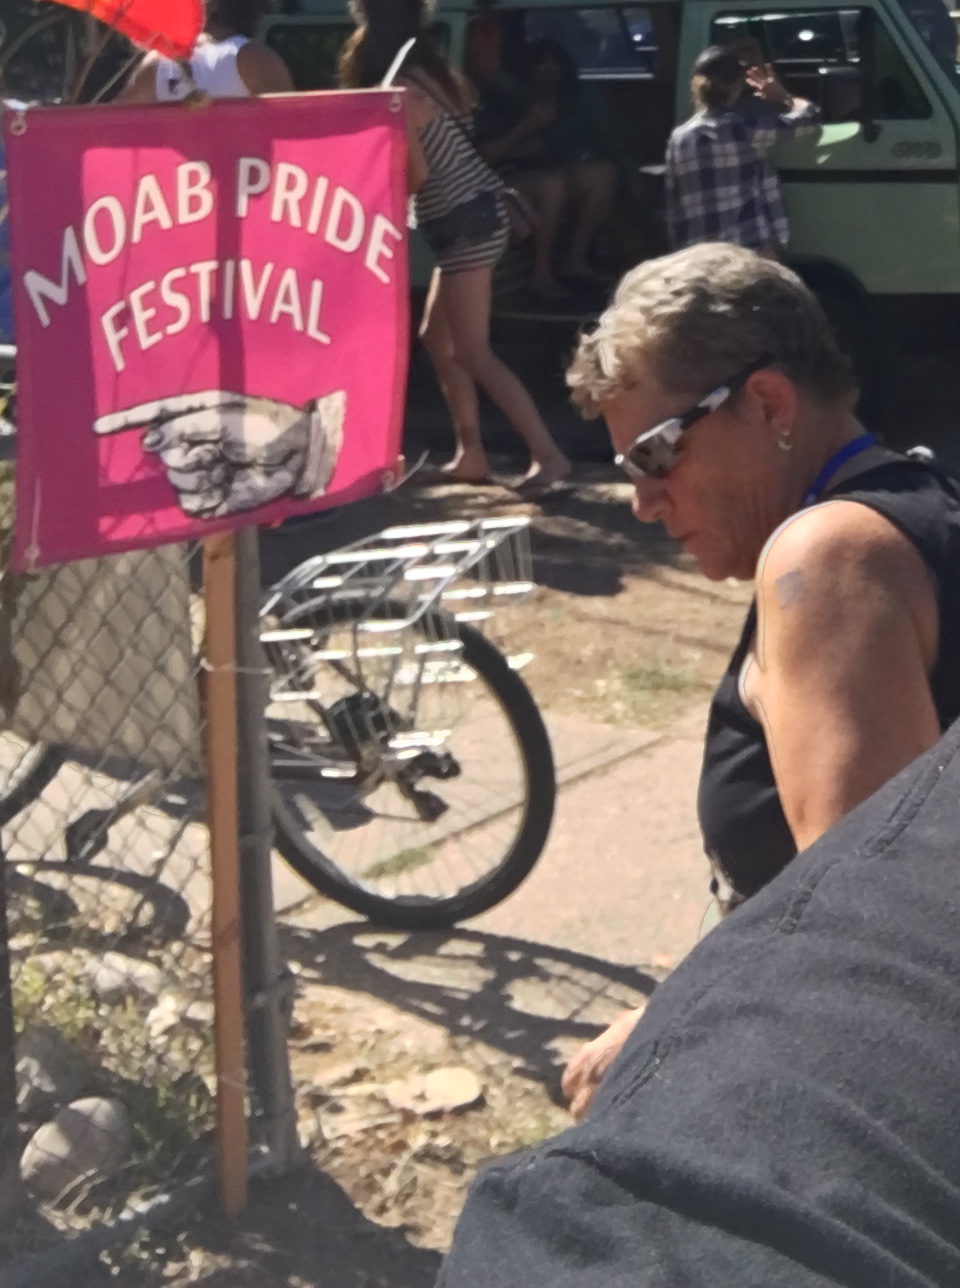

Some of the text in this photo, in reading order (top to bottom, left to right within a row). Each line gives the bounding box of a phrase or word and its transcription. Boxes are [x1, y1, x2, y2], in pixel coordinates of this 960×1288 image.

[23, 157, 402, 327] MOAB PRIDE
[101, 259, 331, 371] FESTIVAL
